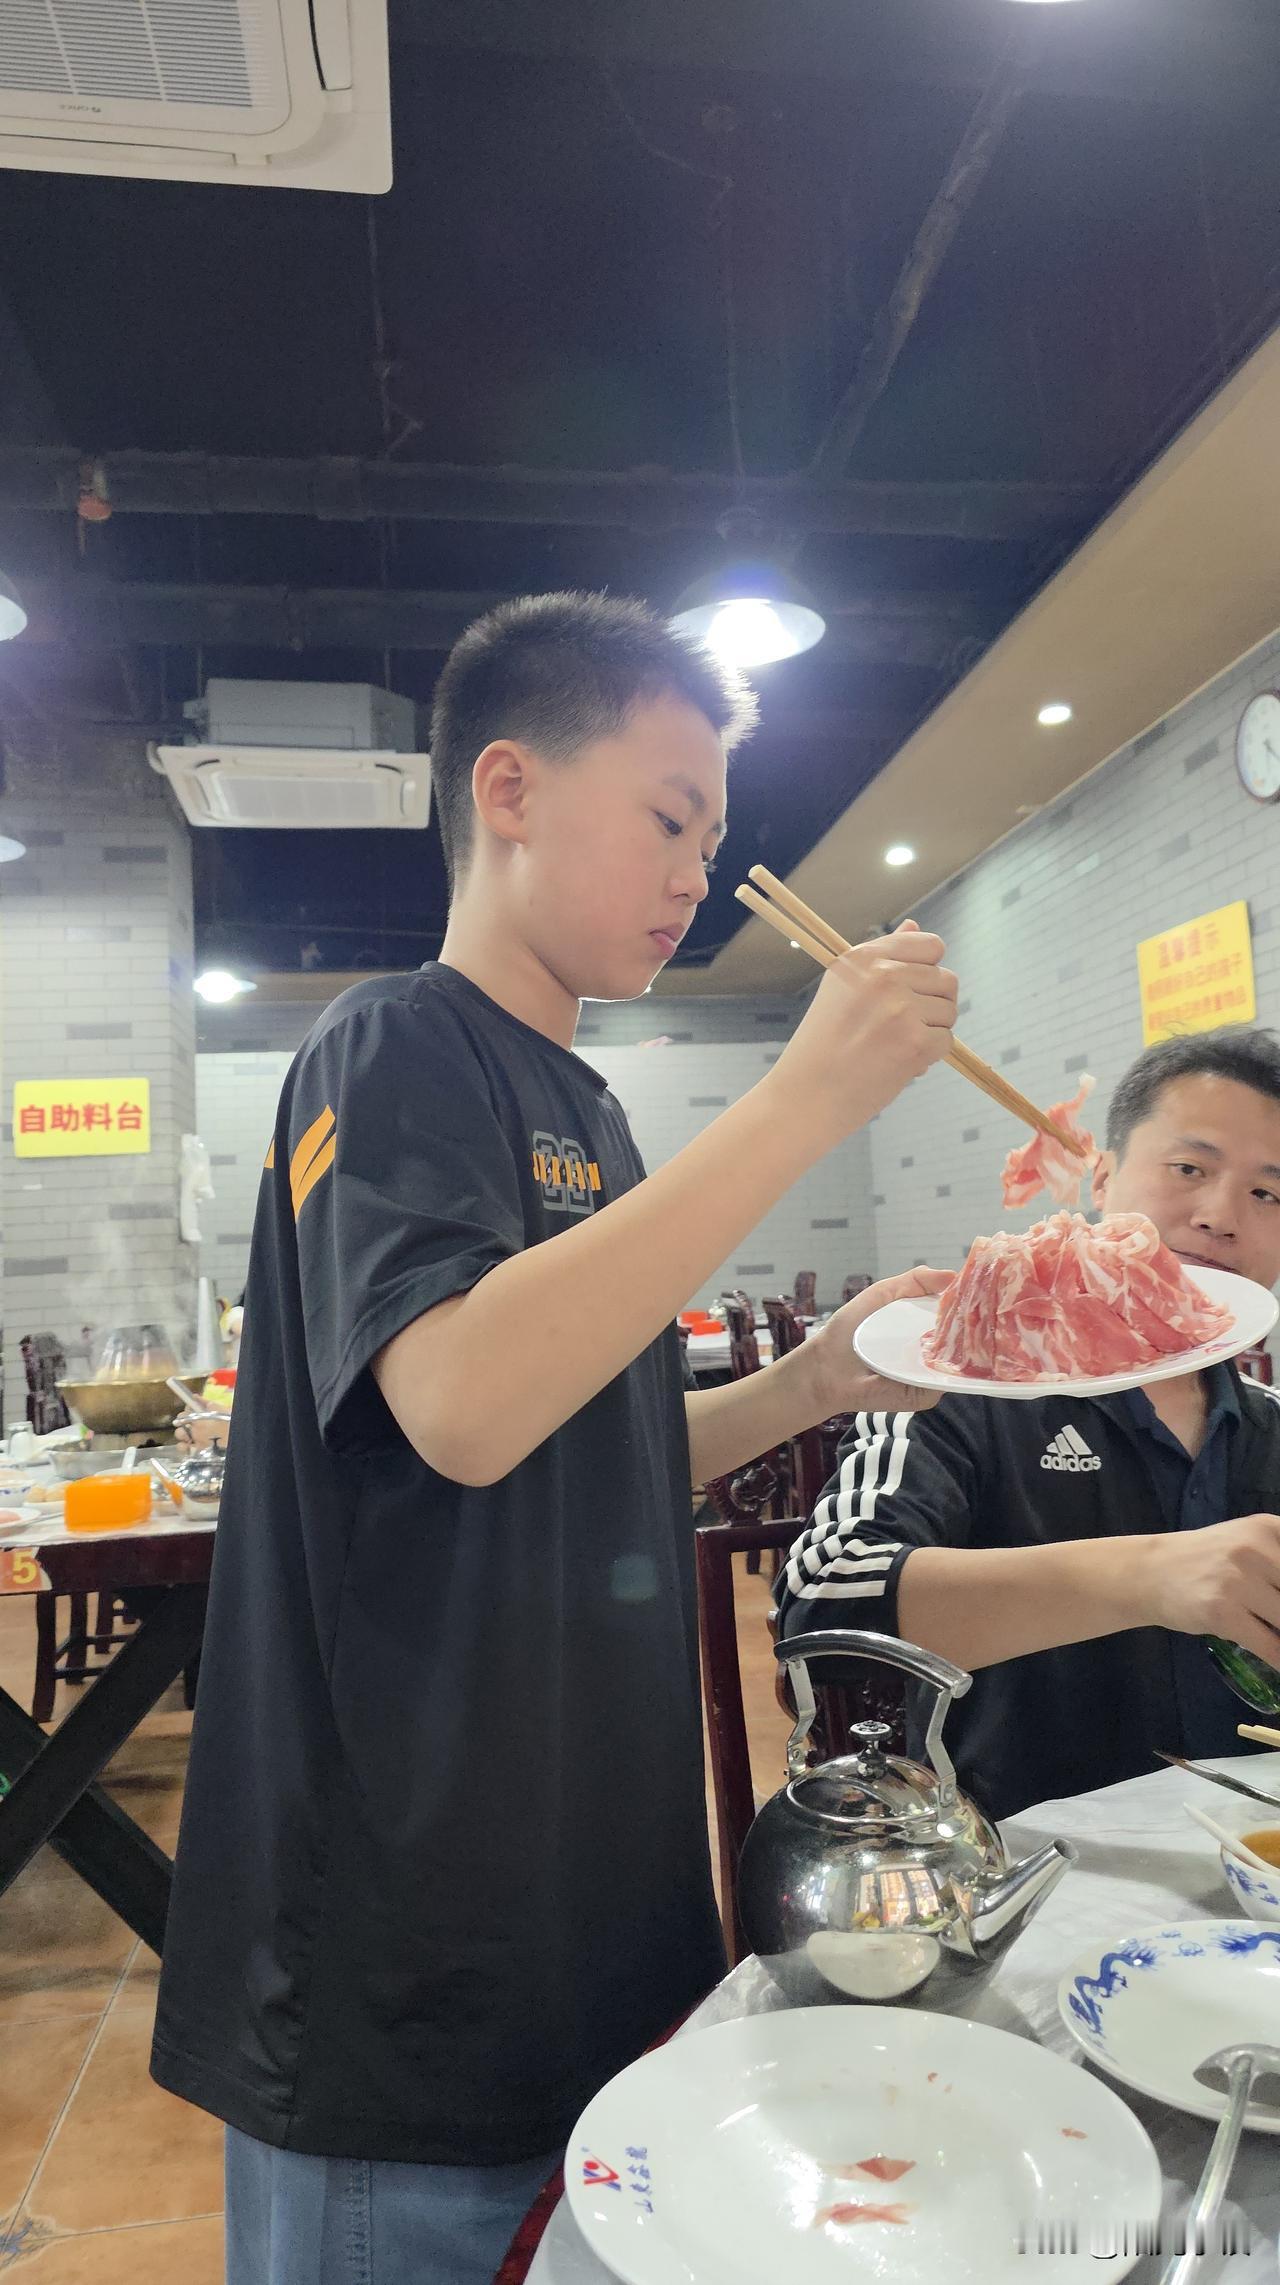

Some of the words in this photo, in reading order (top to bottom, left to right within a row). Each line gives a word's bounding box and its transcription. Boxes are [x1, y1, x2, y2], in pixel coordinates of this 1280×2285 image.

[19, 1101, 143, 1133] 自助料台
[1040, 1453, 1102, 1472] adidas
